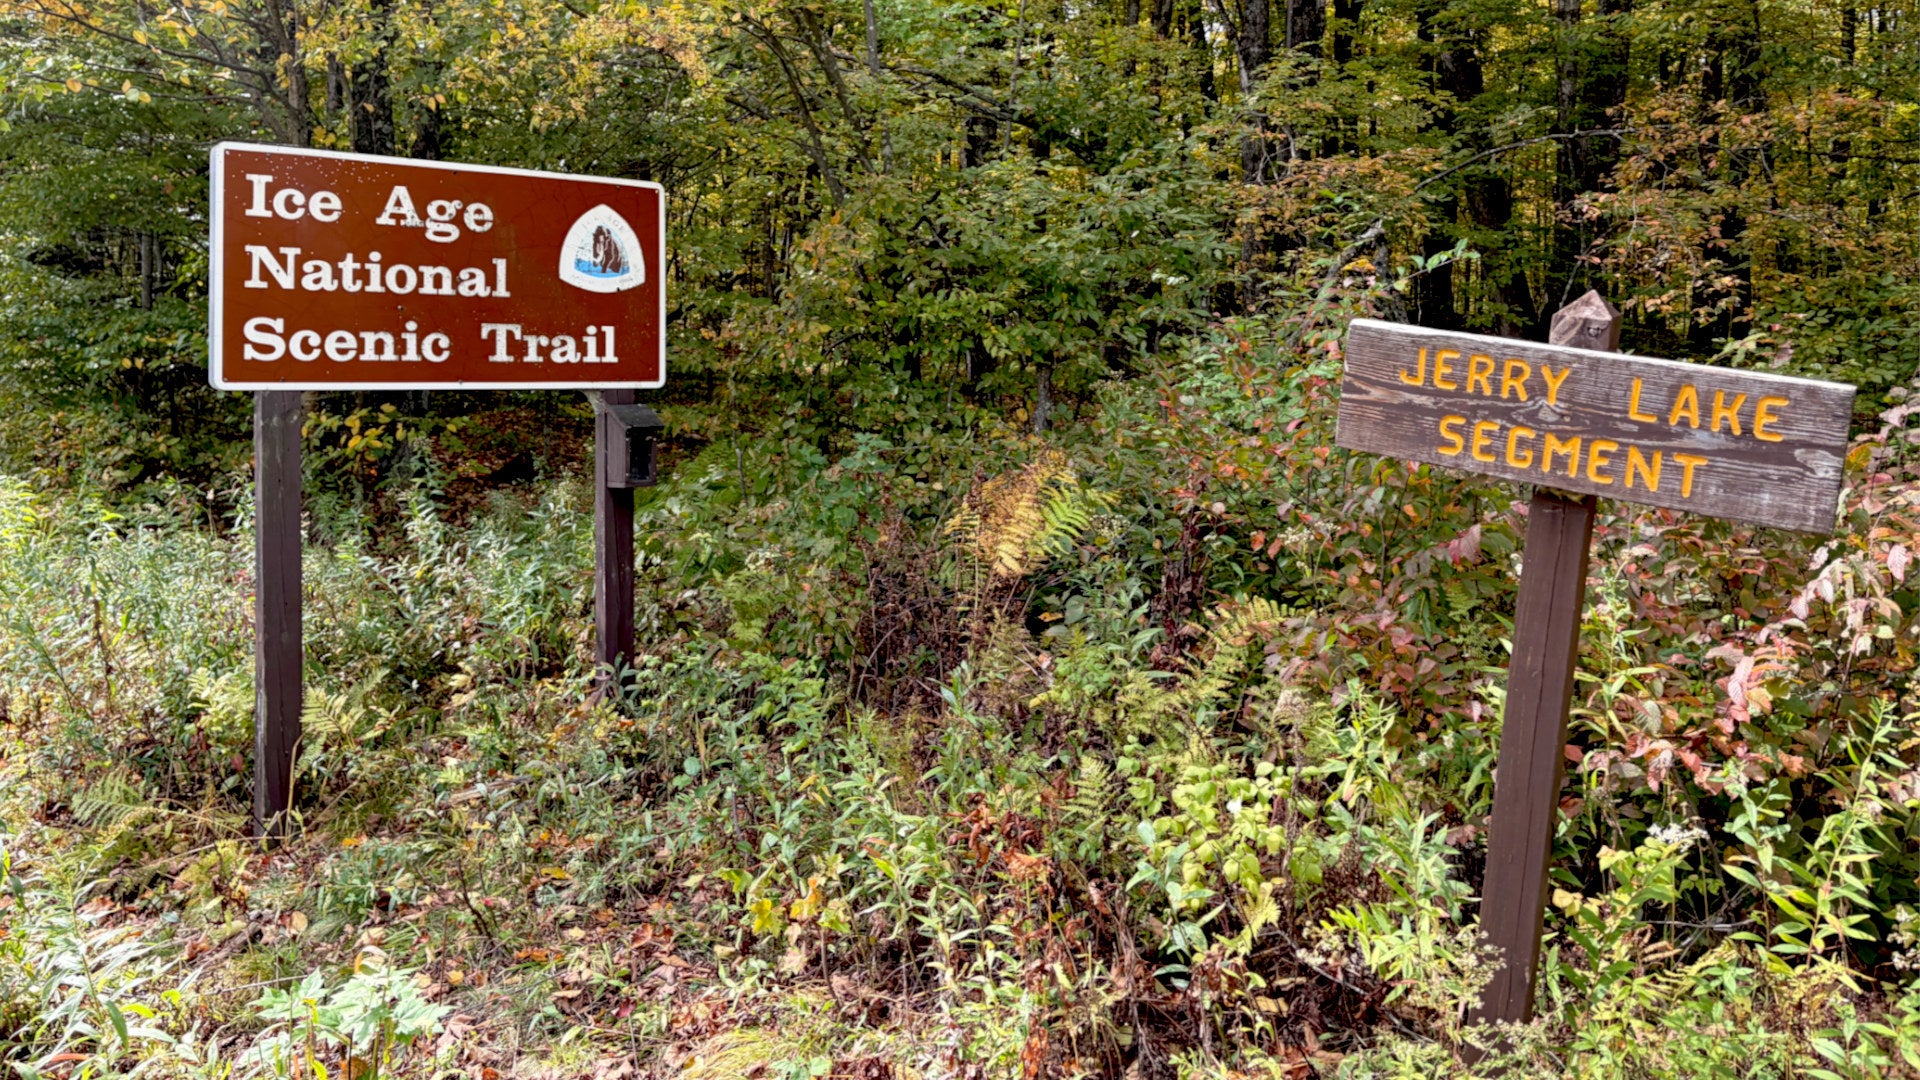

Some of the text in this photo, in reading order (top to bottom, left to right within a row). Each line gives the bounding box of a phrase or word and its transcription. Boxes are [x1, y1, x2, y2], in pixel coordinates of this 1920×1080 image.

[244, 173, 494, 243] Ice Age
[243, 245, 511, 298] National
[243, 317, 619, 364] Scenic Trail
[1400, 347, 1790, 442] JERRY LAKE
[1437, 415, 1709, 498] SEGMENT
